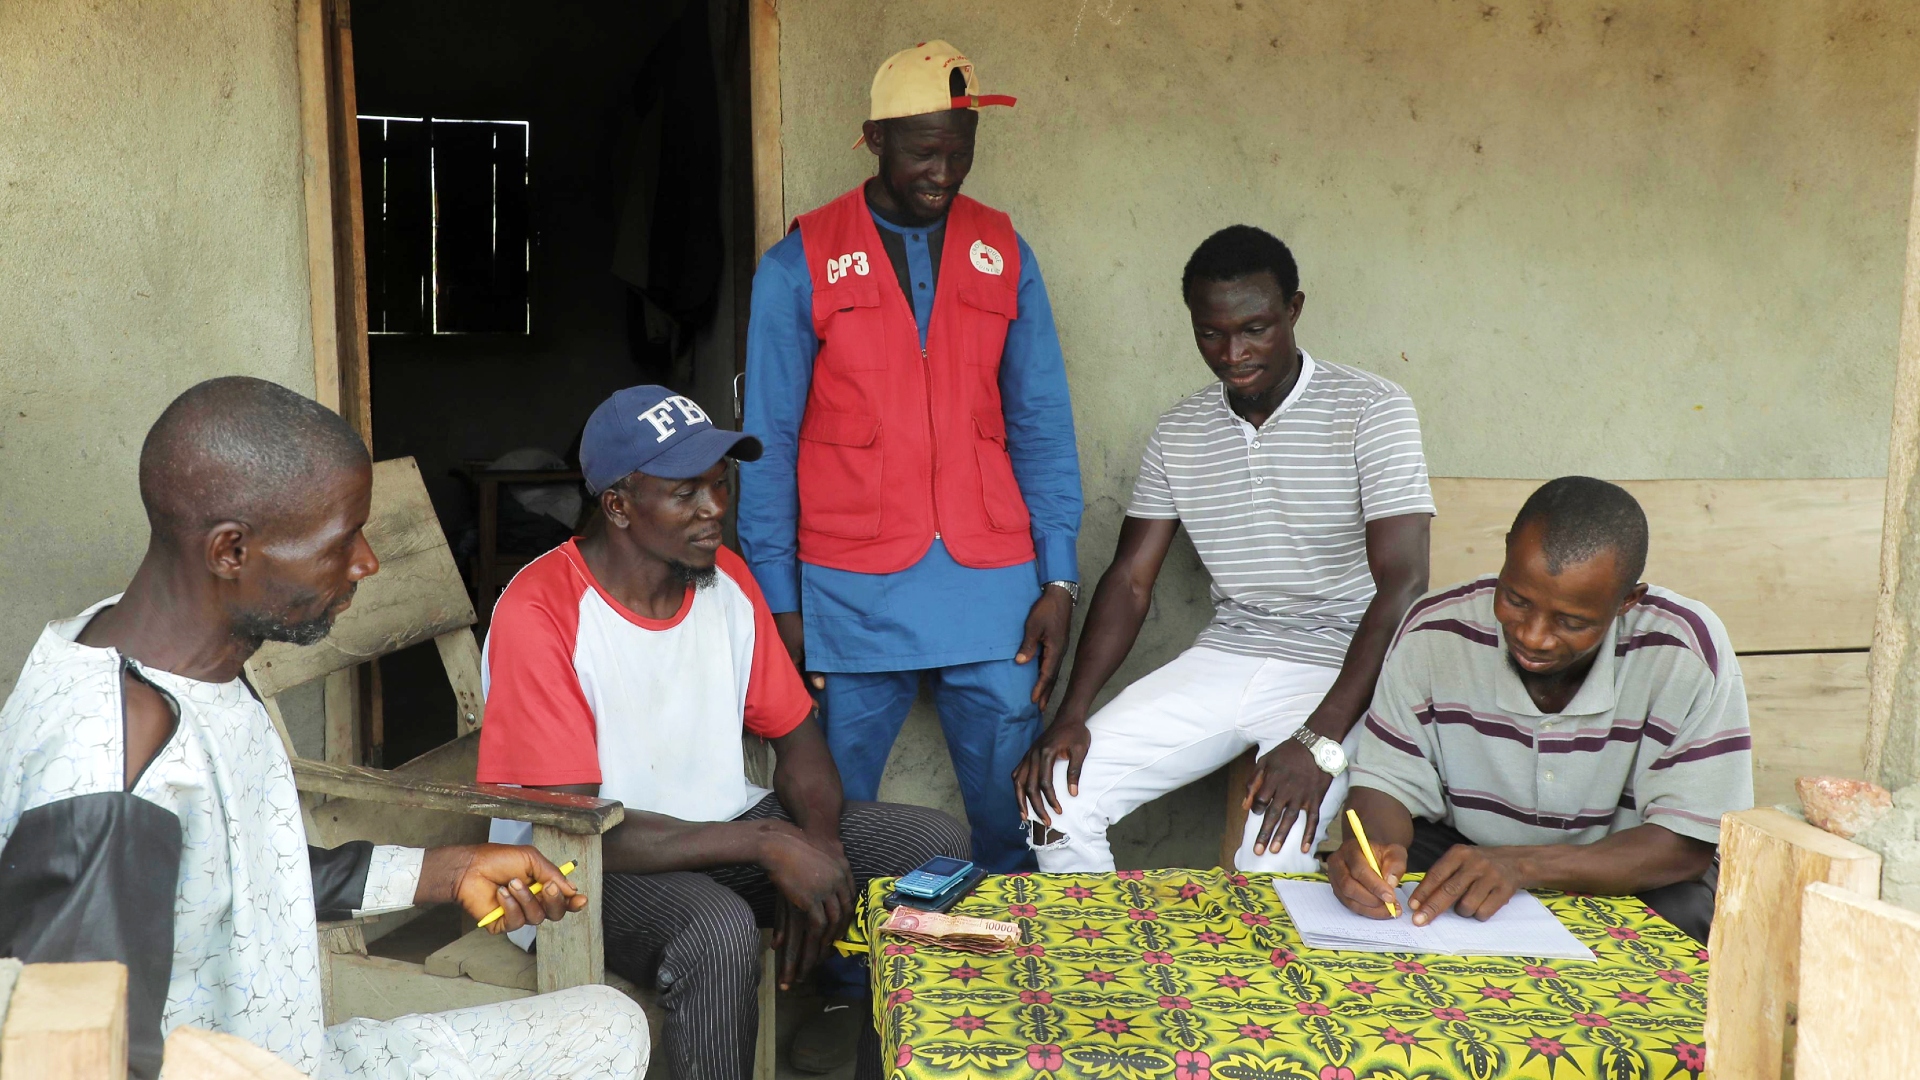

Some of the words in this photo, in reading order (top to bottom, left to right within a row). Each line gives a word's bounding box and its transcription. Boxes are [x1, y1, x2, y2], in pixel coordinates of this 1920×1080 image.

[827, 251, 870, 284] CP3
[637, 395, 712, 443] FB
[985, 922, 1013, 933] 10000
